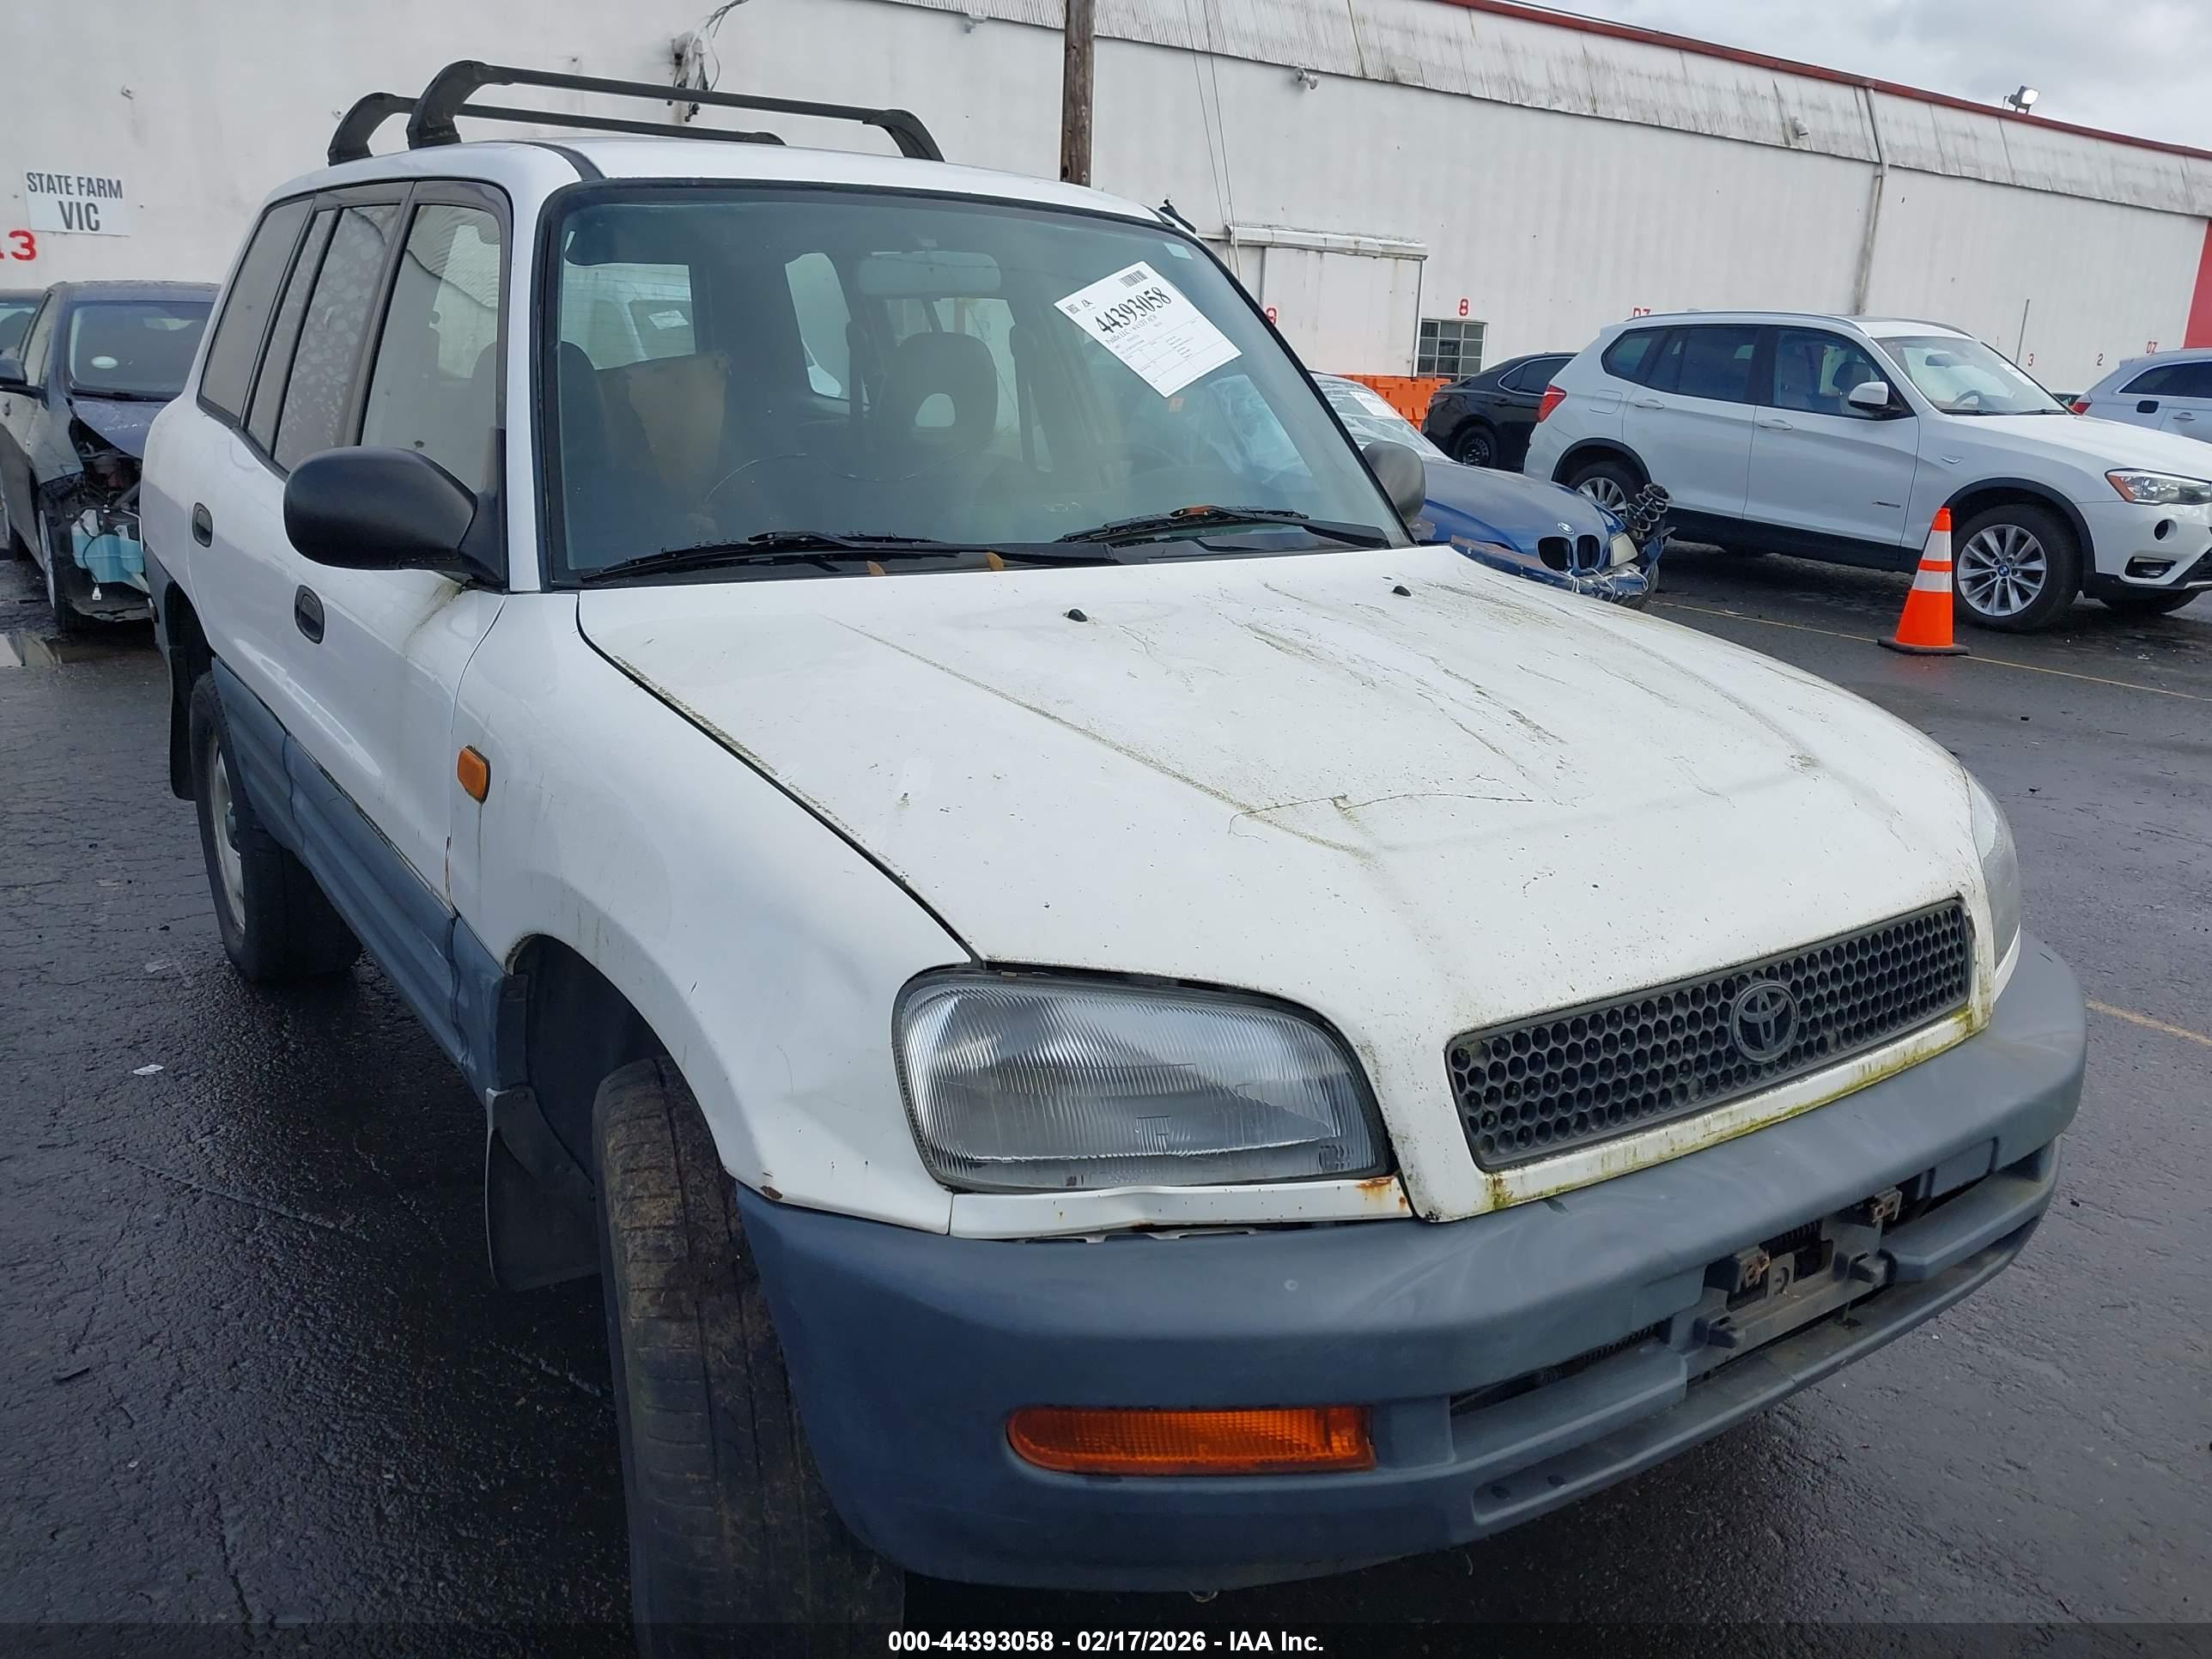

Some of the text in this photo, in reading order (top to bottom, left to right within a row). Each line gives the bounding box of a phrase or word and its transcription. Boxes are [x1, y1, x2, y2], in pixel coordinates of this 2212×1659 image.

[26, 172, 124, 199] STATE FARM
[58, 201, 100, 232] VIC
[1094, 286, 1172, 335] 44393058
[1267, 307, 1277, 325] 9
[1459, 298, 1469, 316] 8
[2027, 353, 2034, 367] 3
[2096, 353, 2104, 367] 2
